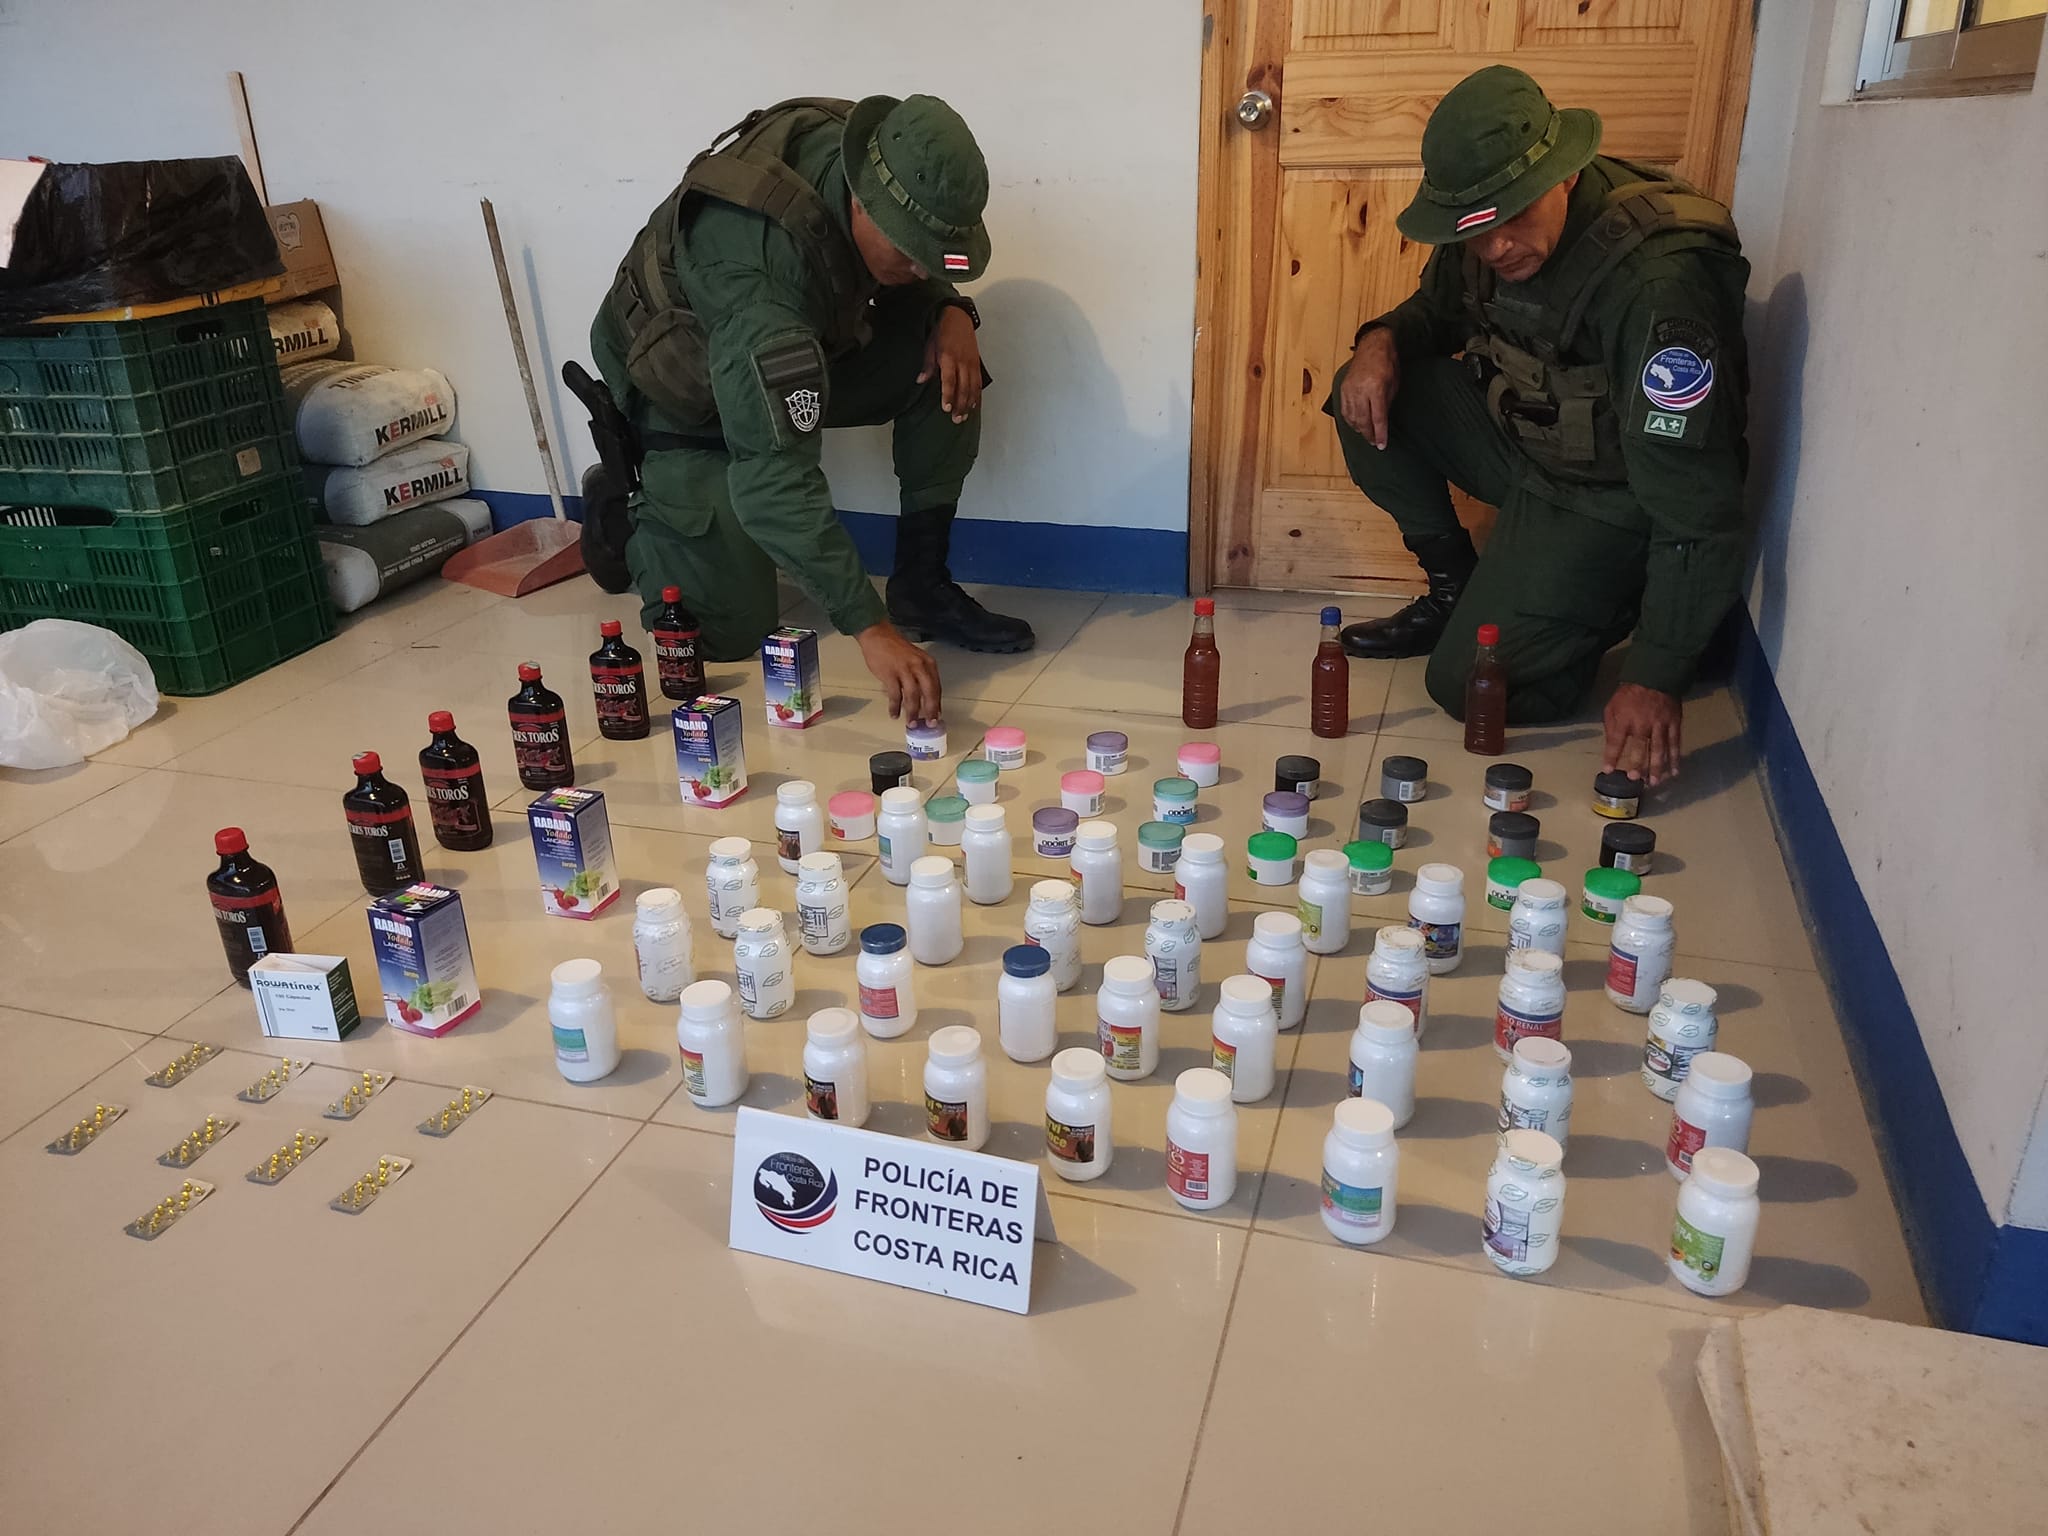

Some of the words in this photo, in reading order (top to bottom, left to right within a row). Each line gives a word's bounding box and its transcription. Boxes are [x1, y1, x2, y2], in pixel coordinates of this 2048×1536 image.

[274, 327, 329, 355] RMILL
[1660, 354, 1696, 367] Fronteras
[375, 403, 447, 446] KERMILL
[1650, 416, 1680, 431] A+
[384, 467, 463, 506] KERMILL
[668, 644, 695, 657] TOROS
[607, 680, 636, 695] TOROS
[527, 728, 560, 743] TOROS
[436, 785, 469, 800] TOROS
[364, 825, 389, 837] TOROS
[386, 931, 414, 947] Yodado
[1516, 1020, 1544, 1031] RENAL
[770, 1158, 815, 1177] Fronteras
[786, 1173, 807, 1185] Costa
[808, 1177, 824, 1188] Rica
[864, 1157, 974, 1200] POLICÍA
[980, 1179, 1019, 1208] DE
[855, 1190, 1023, 1244] FRONTERAS
[854, 1230, 944, 1269] COSTA
[952, 1251, 1019, 1286] RICA
